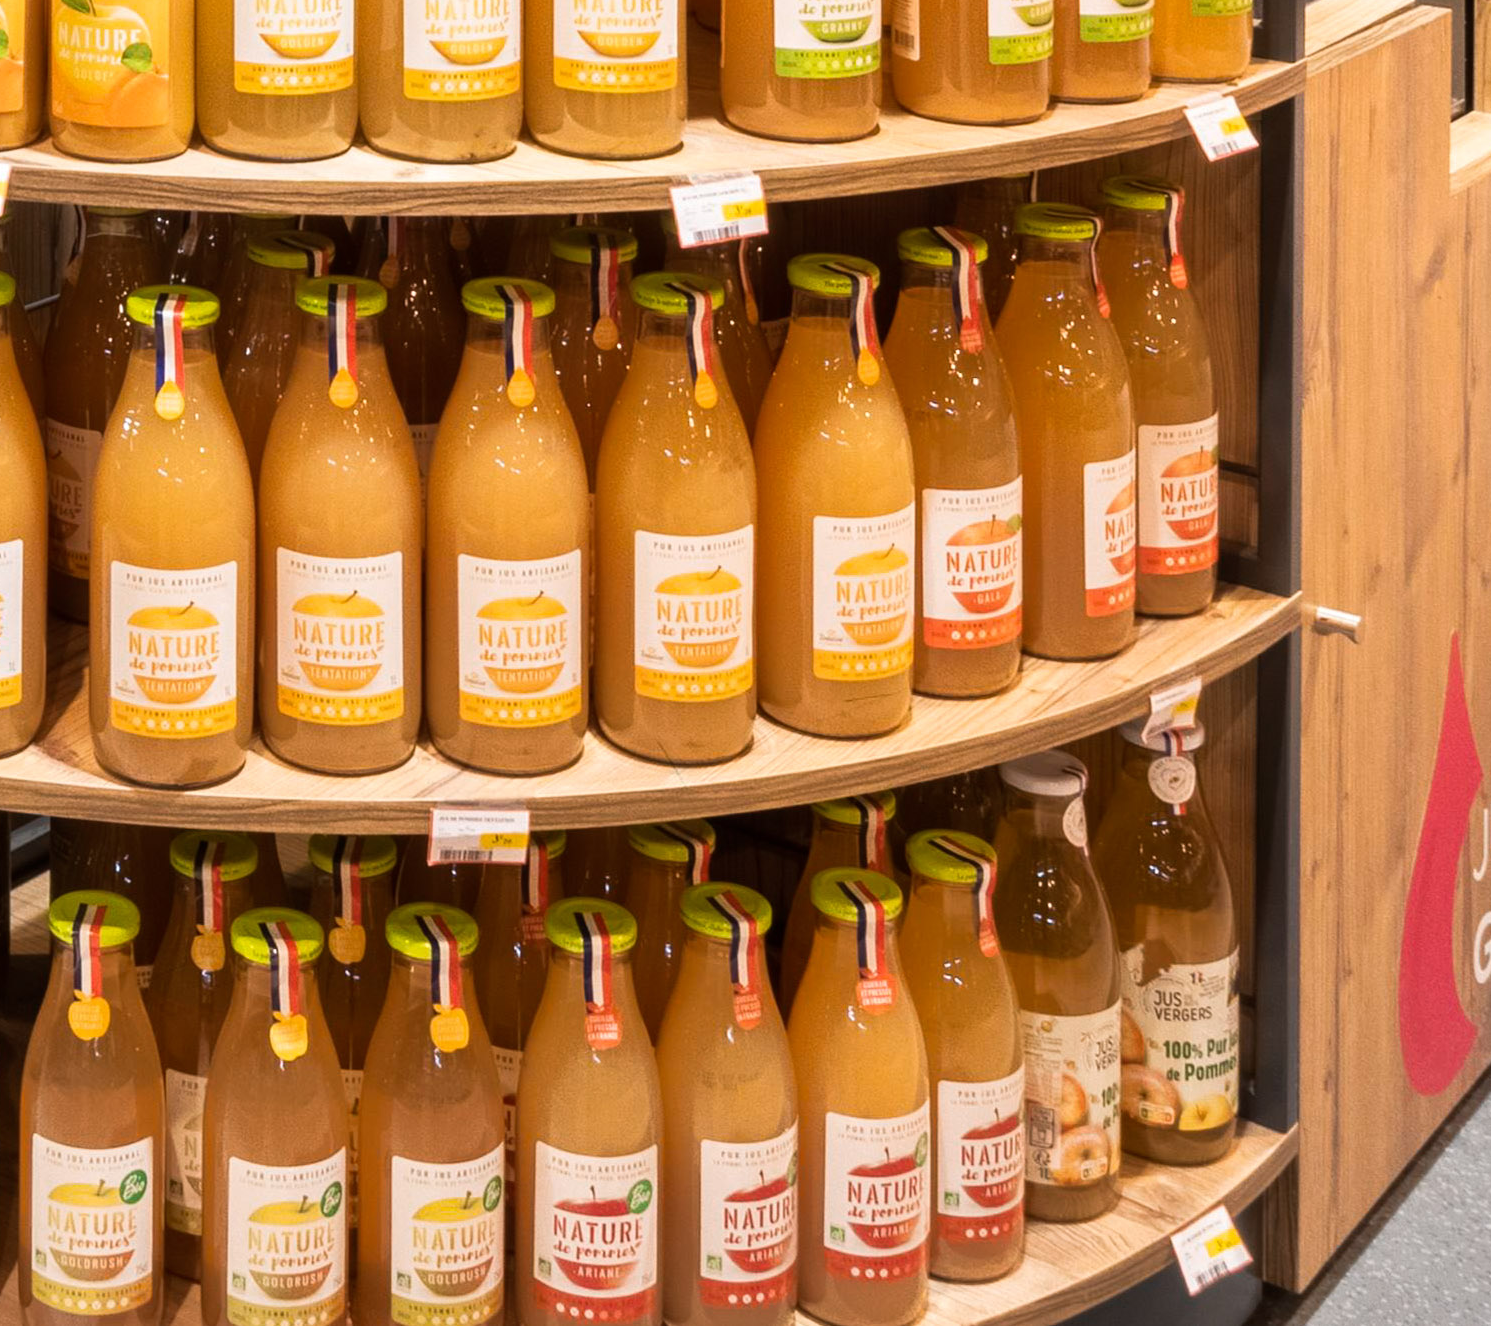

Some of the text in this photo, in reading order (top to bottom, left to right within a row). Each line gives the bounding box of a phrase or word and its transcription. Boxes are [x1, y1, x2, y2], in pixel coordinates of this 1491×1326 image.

[128, 631, 219, 659] NATURE
[293, 617, 386, 646] NATURE
[478, 619, 568, 649] NATURE
[1154, 1006, 1212, 1022] VERGERS
[1163, 1038, 1227, 1059] 100% Pur
[1167, 1055, 1236, 1081] de Pomme
[553, 1214, 643, 1244] NATURE
